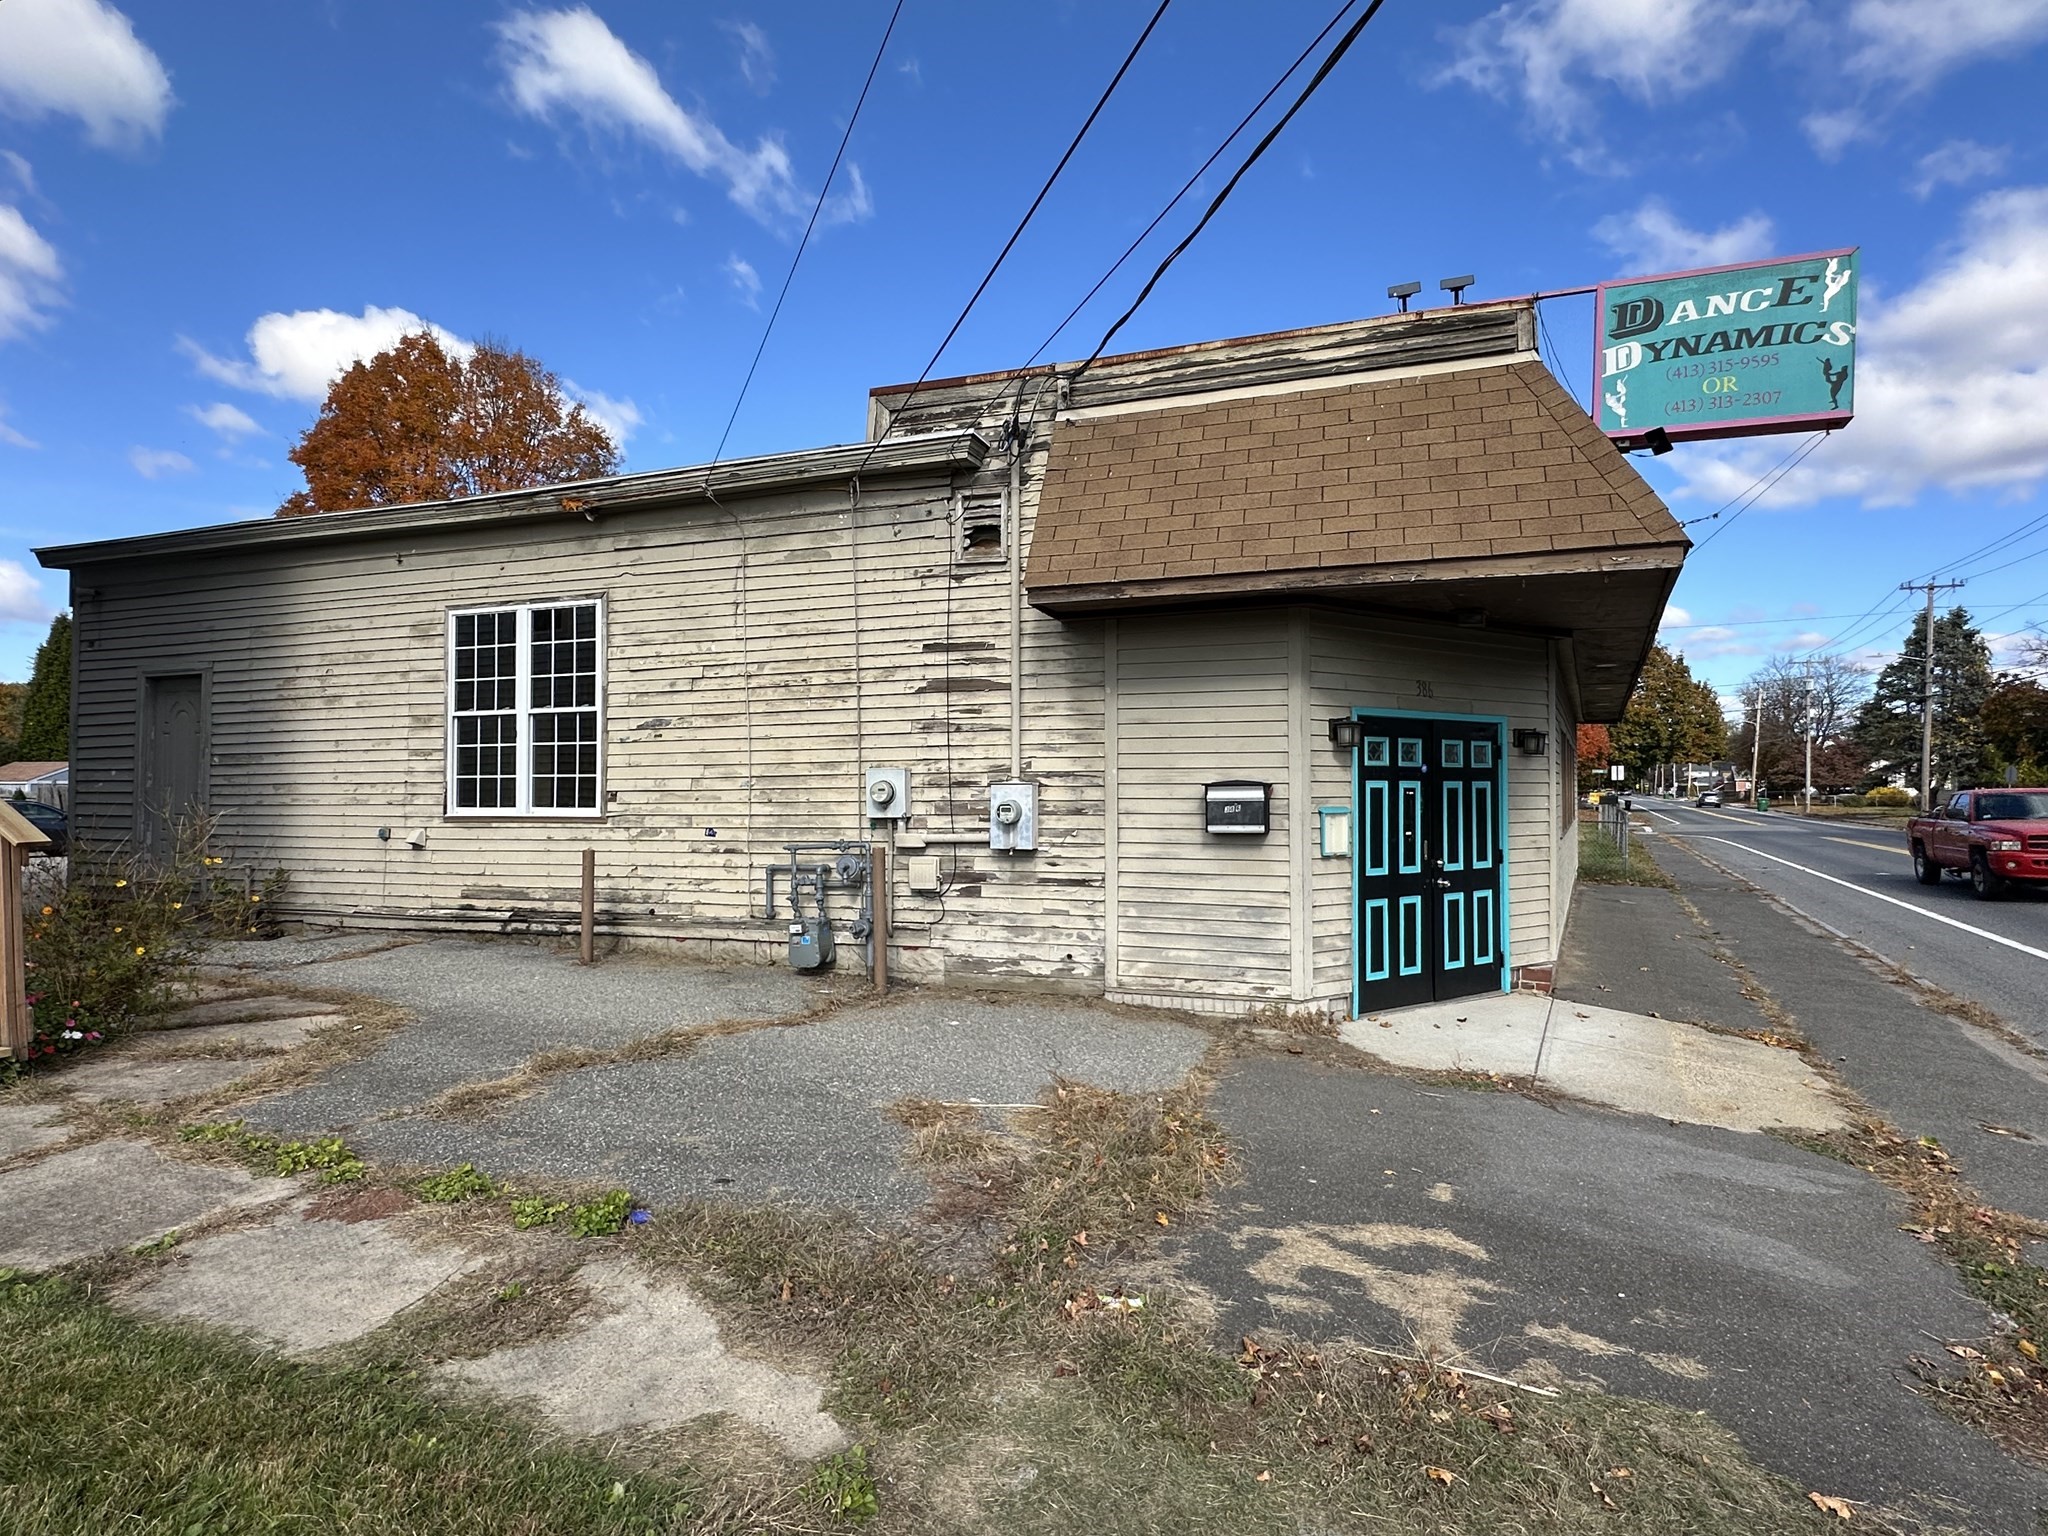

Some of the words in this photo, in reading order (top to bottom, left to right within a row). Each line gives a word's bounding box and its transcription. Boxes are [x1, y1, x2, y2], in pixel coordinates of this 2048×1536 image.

[1608, 275, 1819, 340] DANCE
[1602, 321, 1856, 378] DYNAMICS
[1666, 363, 1705, 382] (413)
[1708, 353, 1780, 375] 315-9595
[1702, 376, 1738, 394] OR
[1664, 397, 1704, 417] (413)
[1707, 391, 1782, 410] 313-2307
